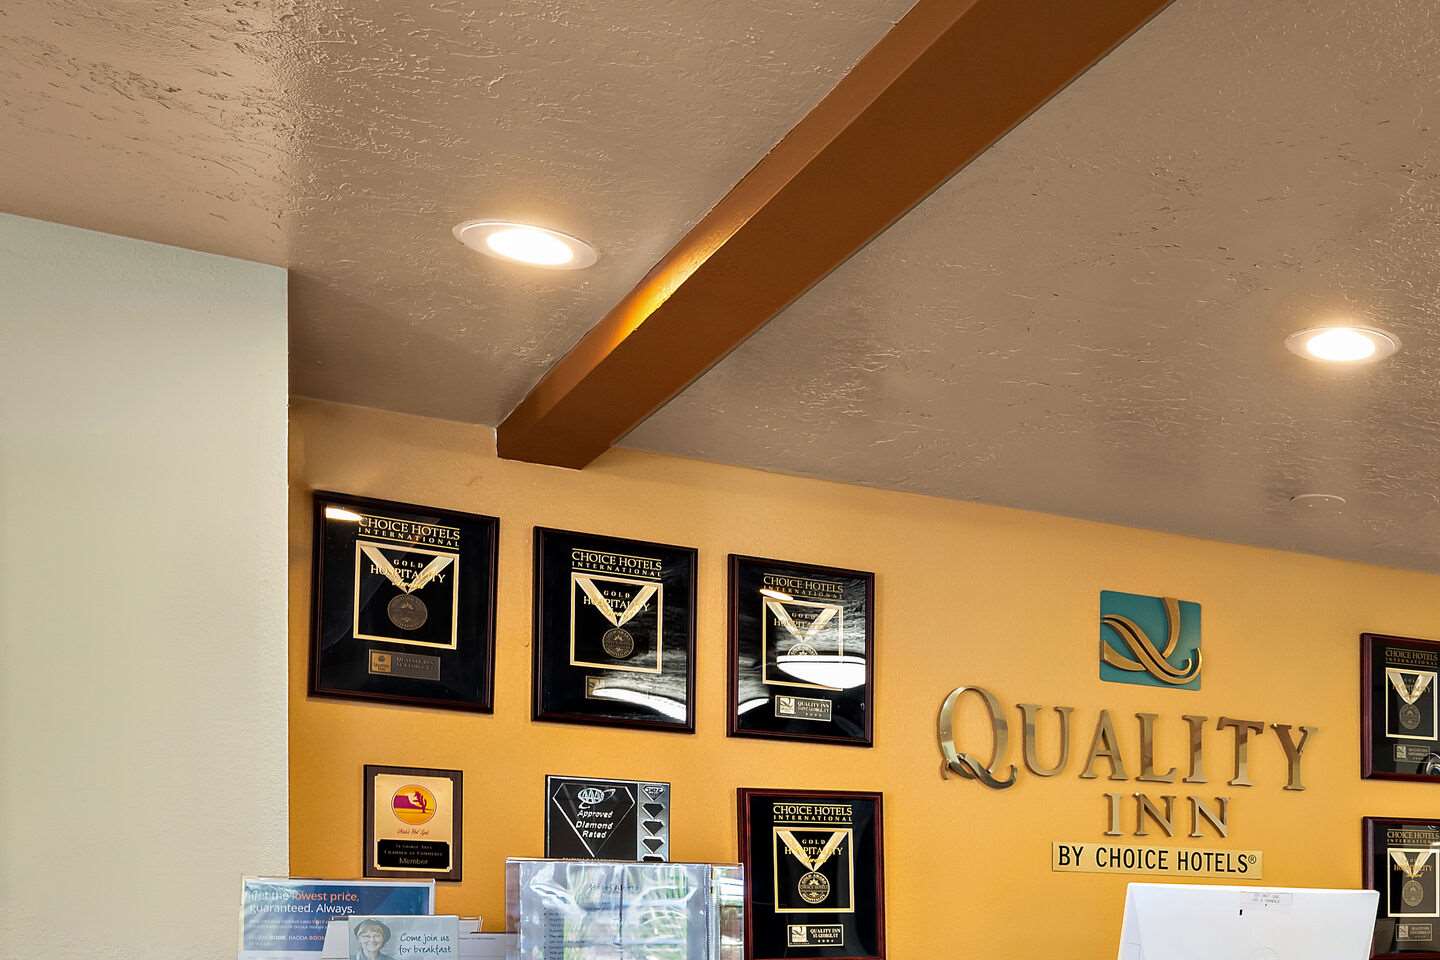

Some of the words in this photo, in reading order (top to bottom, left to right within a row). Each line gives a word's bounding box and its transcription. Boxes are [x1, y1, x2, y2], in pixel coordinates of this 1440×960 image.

[359, 517, 409, 533] CHOICE
[411, 524, 460, 541] HOTELS
[358, 527, 460, 547] INTERNATIONAL
[393, 559, 424, 569] GOLD
[571, 551, 617, 566] CHOICE
[619, 557, 662, 571] HOTELS
[571, 561, 662, 577] INTERNATIONAL
[763, 576, 803, 589] CHOICE
[805, 580, 844, 594] HOTELS
[603, 590, 630, 599] GOLD
[1385, 649, 1411, 660] CHOICE
[937, 685, 1319, 791] QUALITY
[576, 809, 614, 819] Approved
[773, 805, 813, 815] CHOICE
[814, 806, 853, 816] HOTELS
[1103, 793, 1231, 838] INN
[773, 814, 853, 822] INTERNATIONAL
[575, 820, 614, 830] Diamond
[582, 830, 608, 839] Rated
[1386, 830, 1412, 840] CHOICE
[1413, 831, 1440, 840] HOTELS
[1058, 845, 1085, 867] BY
[1096, 847, 1169, 871] CHOICE
[316, 904, 356, 916] Always.
[400, 933, 421, 942] Come
[422, 933, 439, 943] join
[399, 945, 411, 956] for
[413, 945, 452, 956] breakfast
